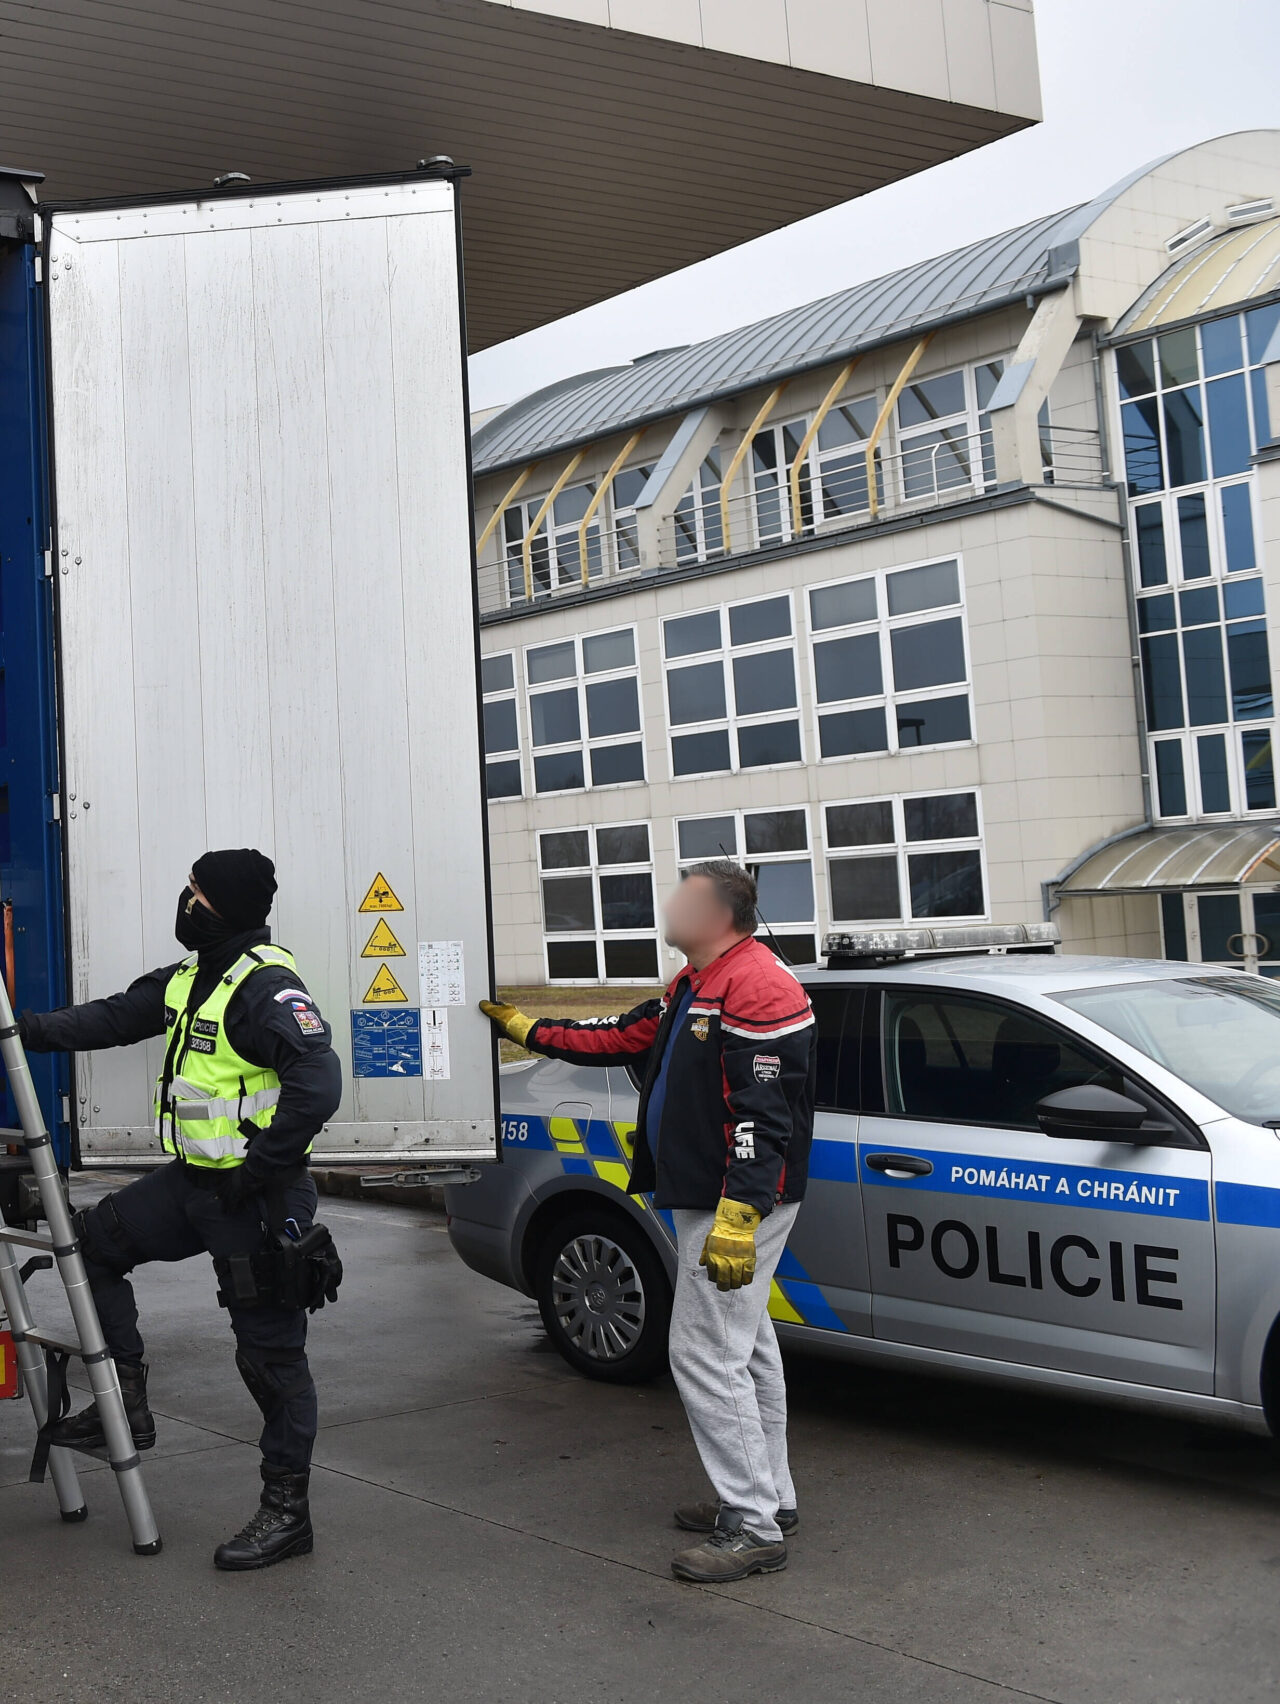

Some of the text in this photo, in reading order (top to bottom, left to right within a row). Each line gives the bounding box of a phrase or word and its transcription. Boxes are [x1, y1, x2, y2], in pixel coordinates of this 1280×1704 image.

[500, 1120, 528, 1141] 158
[951, 1166, 1180, 1207] POMÁHAT A CHRÁNIT
[886, 1213, 1184, 1311] POLICIE
